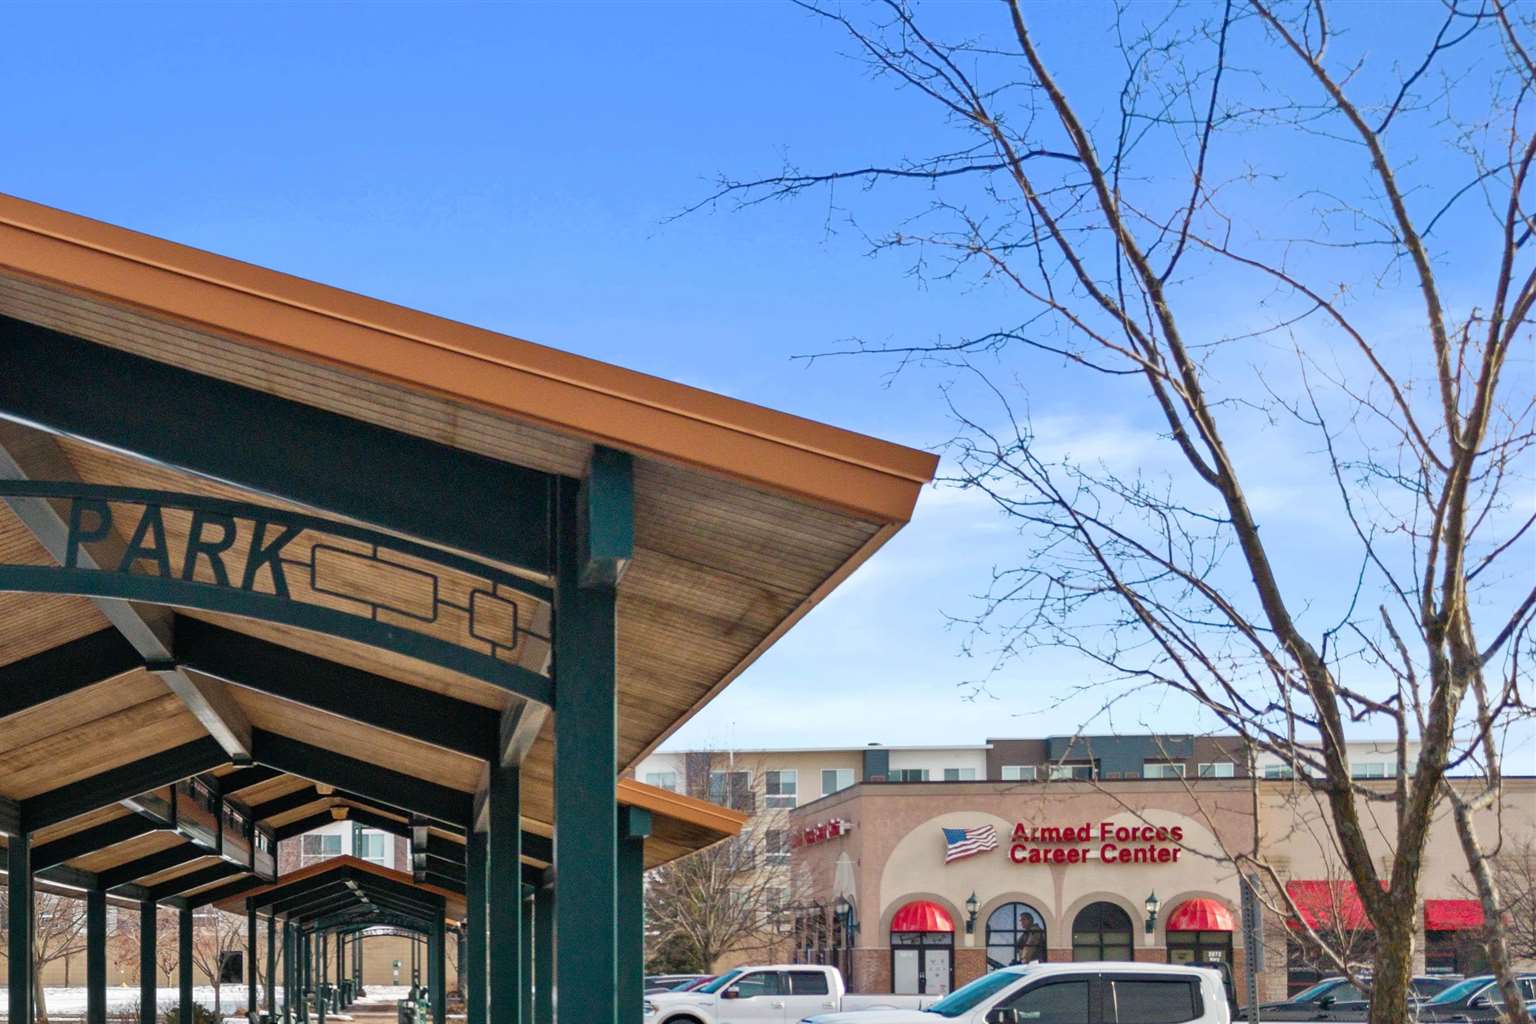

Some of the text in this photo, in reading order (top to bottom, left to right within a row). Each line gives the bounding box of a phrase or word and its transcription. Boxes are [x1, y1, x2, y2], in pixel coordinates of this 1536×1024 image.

[65, 498, 306, 600] PARK
[1011, 822, 1183, 842] Armed Forces
[1010, 843, 1181, 864] Career Center
